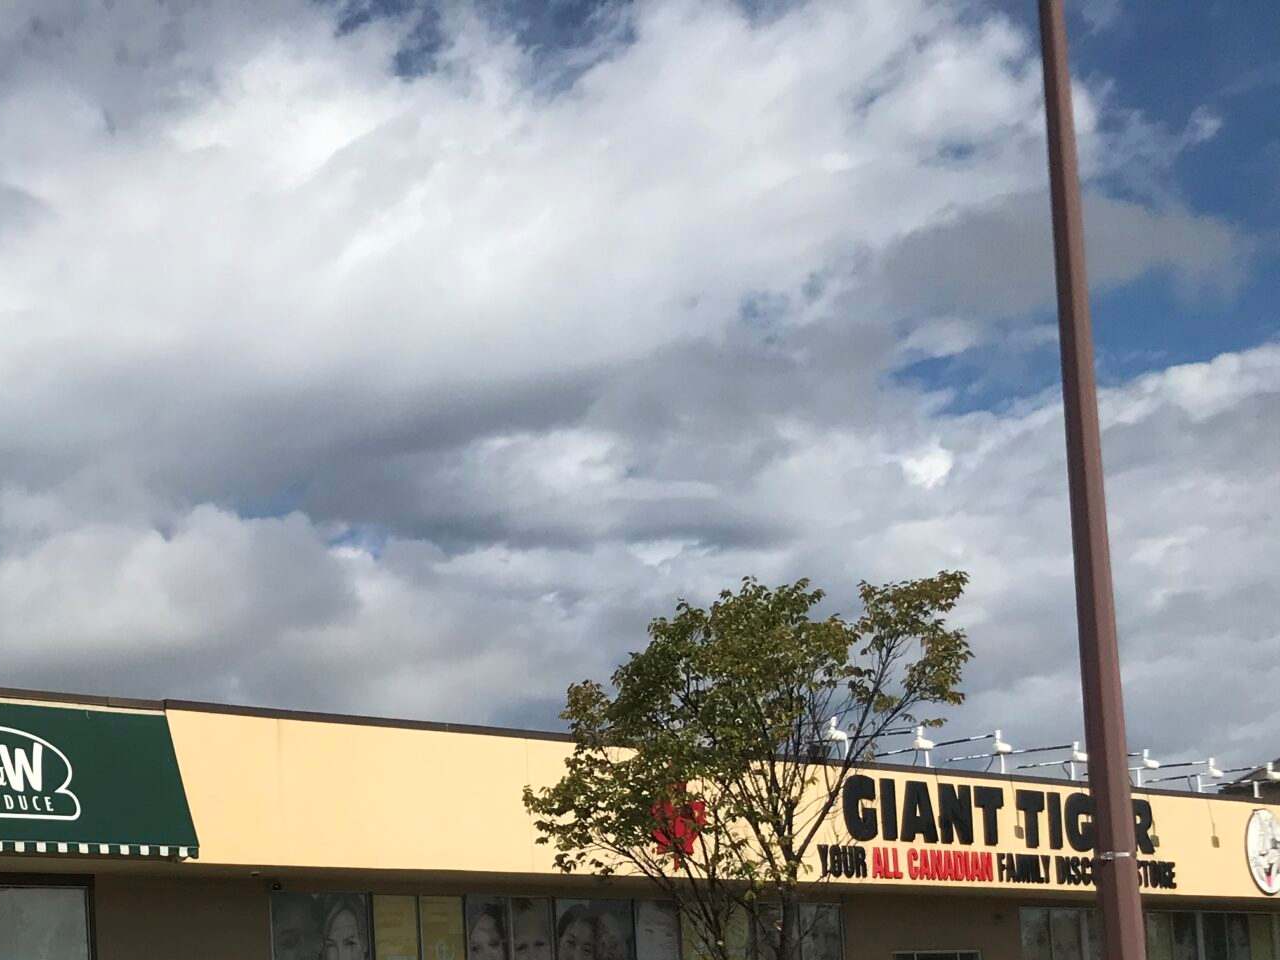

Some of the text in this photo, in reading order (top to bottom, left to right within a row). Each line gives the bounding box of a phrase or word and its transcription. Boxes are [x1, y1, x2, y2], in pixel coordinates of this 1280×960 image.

[842, 774, 1154, 855] GIANT TIGR
[817, 843, 867, 878] YOUR
[871, 847, 903, 879] ALL
[906, 847, 993, 882] CANADIAN
[996, 852, 1050, 884] FAMILY
